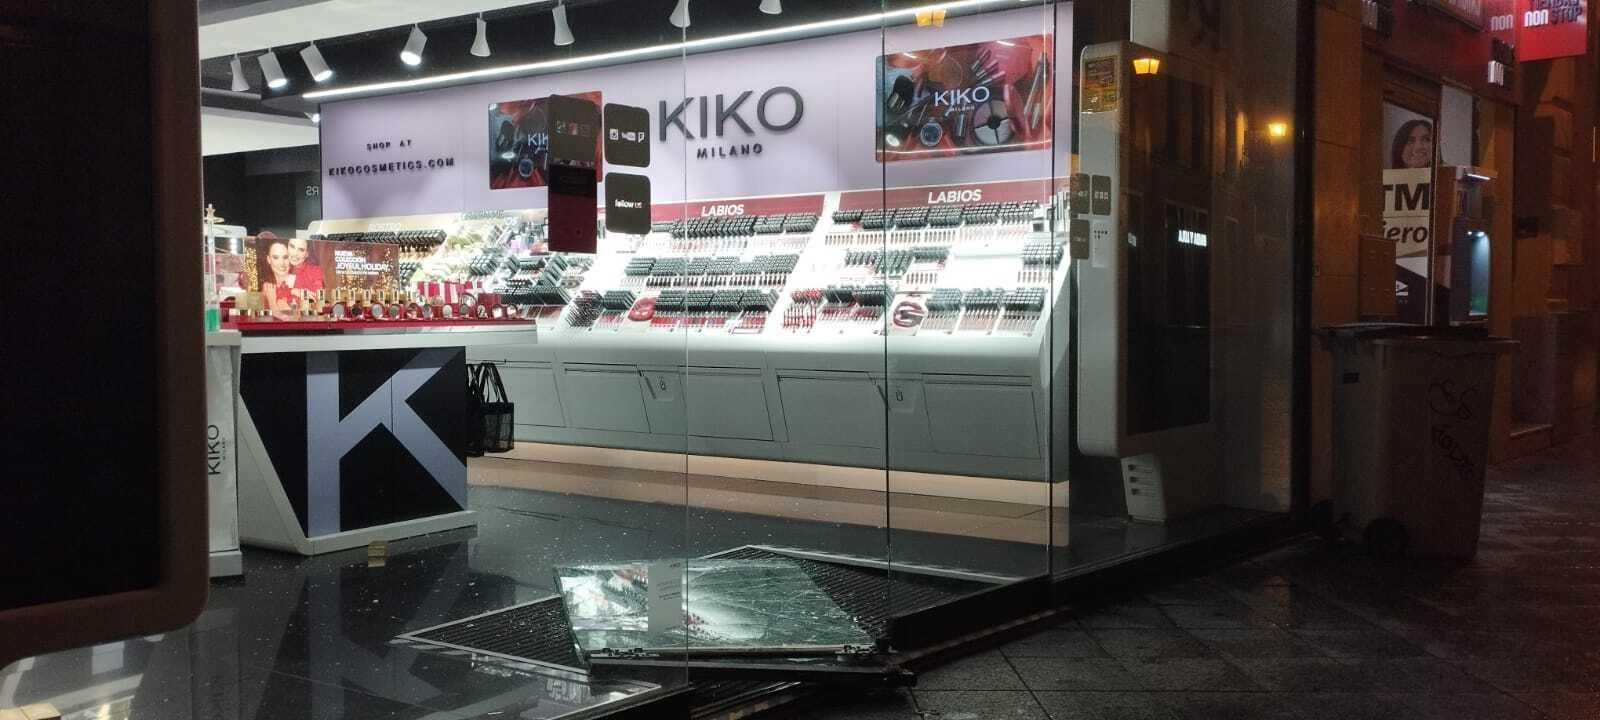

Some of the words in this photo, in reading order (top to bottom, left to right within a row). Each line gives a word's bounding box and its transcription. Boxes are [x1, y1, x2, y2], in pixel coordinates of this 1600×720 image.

[934, 86, 990, 106] KIKO
[659, 86, 804, 142] KIKO
[366, 141, 391, 151] SHOP
[399, 139, 412, 148] AT
[696, 143, 763, 159] MILANO
[328, 157, 455, 177] KIKOCOSMETICS.COM
[928, 188, 982, 205] LABIOS
[701, 203, 745, 217] LABIOS
[208, 424, 221, 475] KIKO
